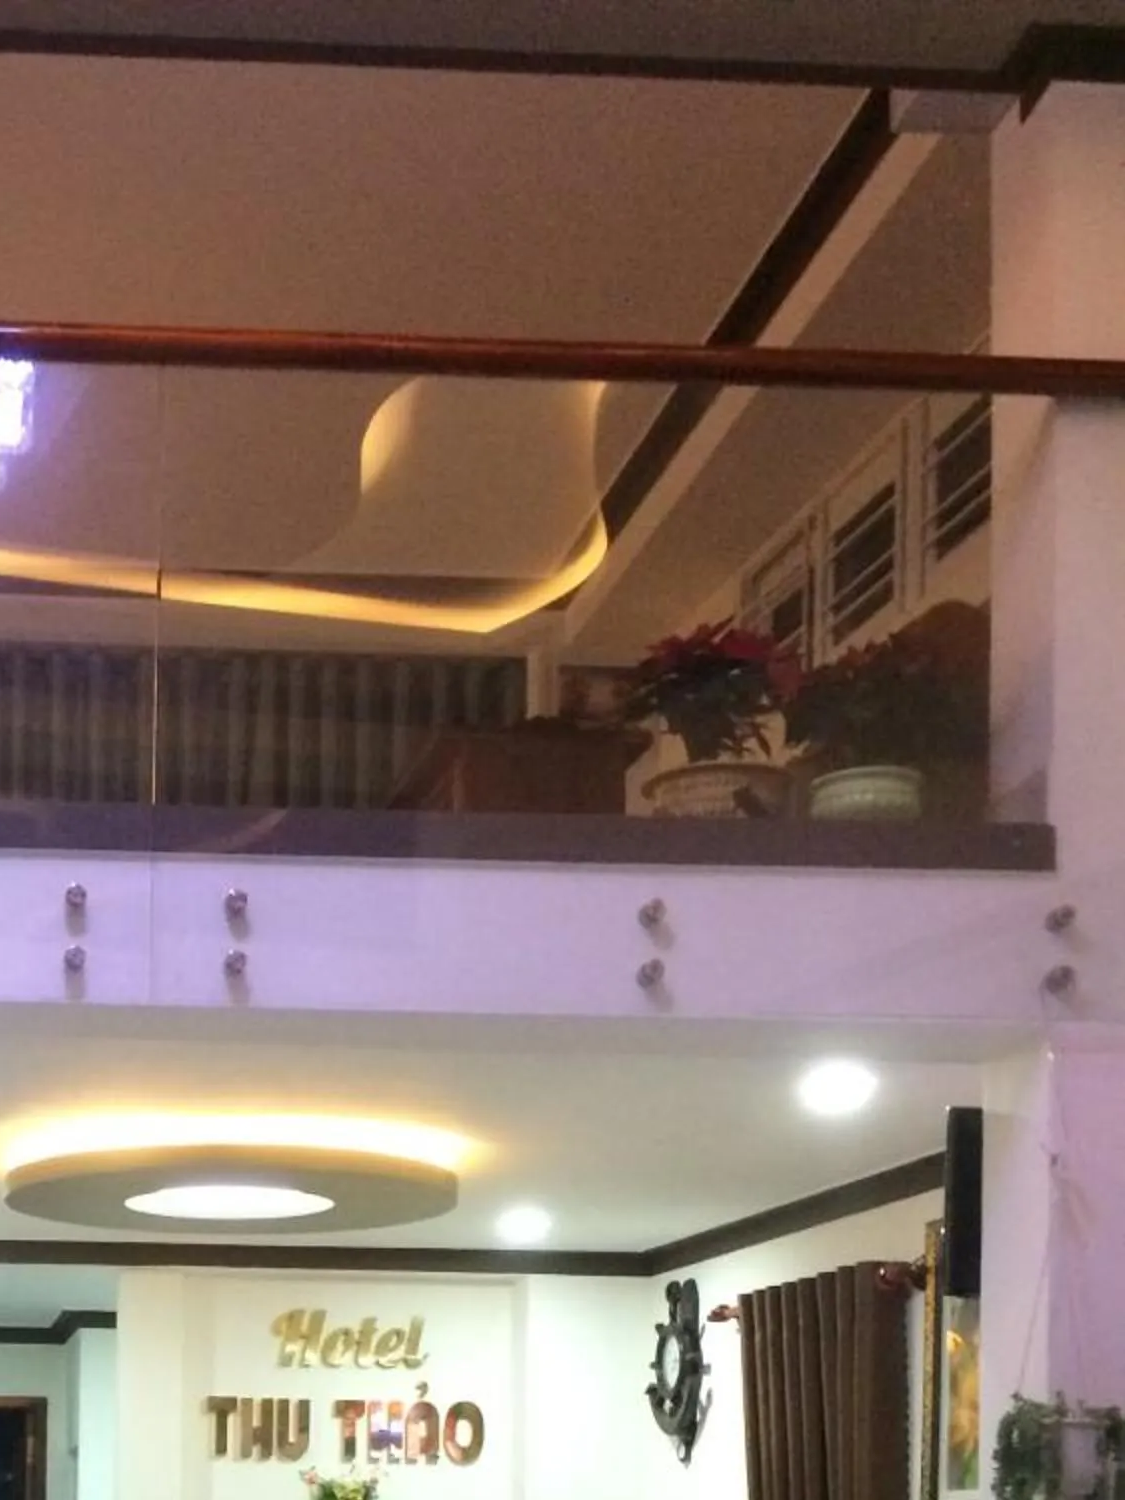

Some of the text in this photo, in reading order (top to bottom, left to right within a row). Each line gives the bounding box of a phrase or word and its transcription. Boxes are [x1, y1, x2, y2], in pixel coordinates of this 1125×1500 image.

[271, 1309, 428, 1369] Hotel
[205, 1381, 484, 1466] THU THẢO
